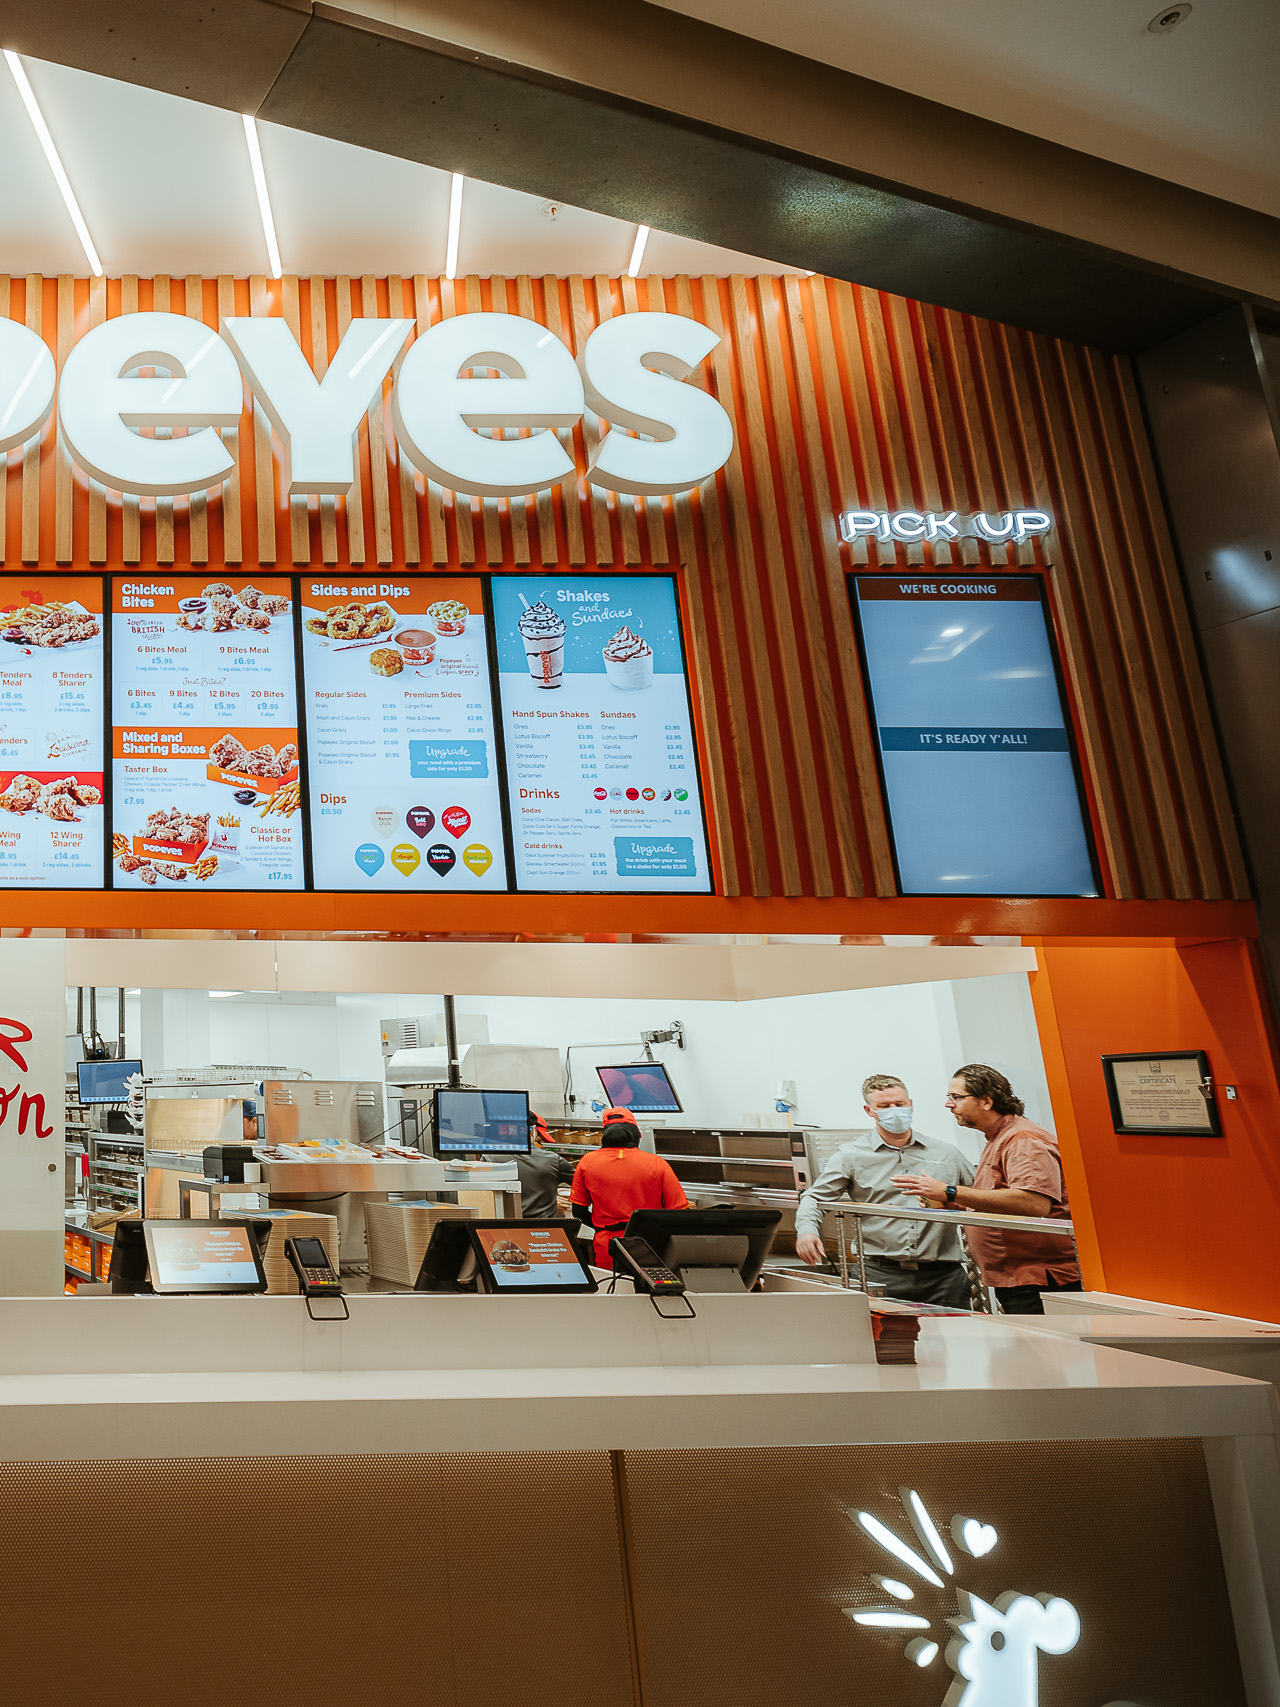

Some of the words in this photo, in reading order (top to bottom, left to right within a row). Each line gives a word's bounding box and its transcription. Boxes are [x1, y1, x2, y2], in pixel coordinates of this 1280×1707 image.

[844, 512, 959, 540] PICK
[974, 512, 1051, 541] UP
[121, 584, 175, 595] Chicken
[311, 584, 348, 596] Sides
[351, 584, 377, 596] and
[379, 584, 410, 598] Dips
[899, 585, 938, 594] WE'RE
[940, 585, 997, 594] COOKING
[556, 589, 610, 602] Shakes
[122, 596, 155, 608] Bites
[579, 603, 600, 612] and
[572, 607, 633, 627] Sundaes
[234, 657, 255, 665] £6.95
[58, 679, 86, 687] Sharer
[315, 691, 344, 699] Regular
[537, 711, 558, 719] Spun
[600, 711, 636, 719] Sundaes
[122, 732, 158, 743] Mixed
[160, 732, 183, 743] and
[920, 733, 943, 745] IT'S
[945, 733, 987, 745] READY
[989, 733, 1028, 745] Y'ALL!
[47, 739, 90, 759] Louisiana
[122, 744, 169, 755] Sharing
[171, 744, 206, 754] Boxes
[425, 746, 470, 759] Upgrade
[320, 793, 347, 805] Dips
[520, 788, 560, 799] Drinks
[125, 797, 144, 805] £7.95
[60, 832, 83, 840] Wing
[631, 843, 677, 856] Upgrade
[268, 872, 293, 880] £17.95
